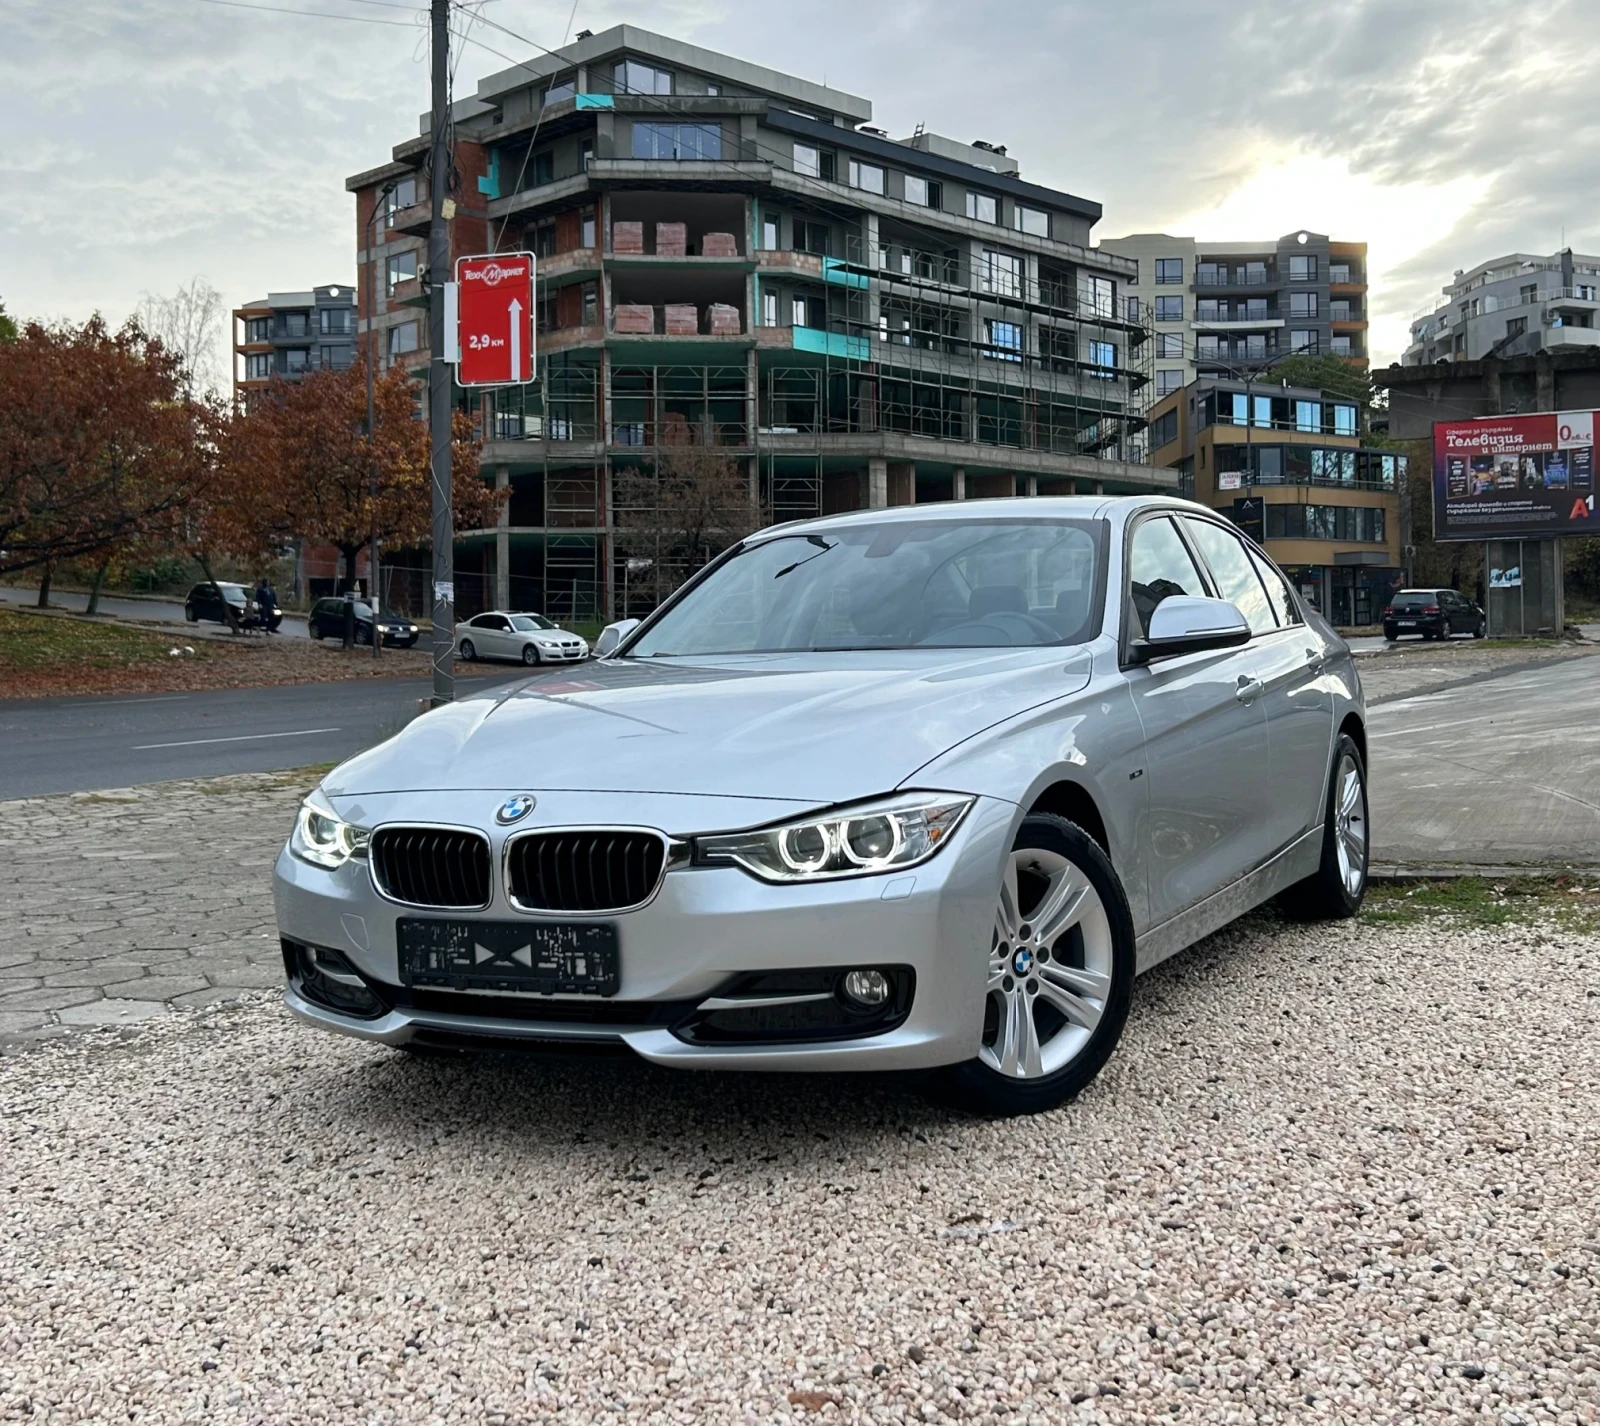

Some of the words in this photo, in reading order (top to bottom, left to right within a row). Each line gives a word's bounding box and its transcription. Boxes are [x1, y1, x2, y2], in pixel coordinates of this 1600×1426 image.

[469, 334, 490, 350] 2,9
[491, 338, 504, 347] км
[1446, 434, 1524, 447] Телевизия
[1492, 442, 1552, 453] интернет
[1569, 494, 1594, 519] A1
